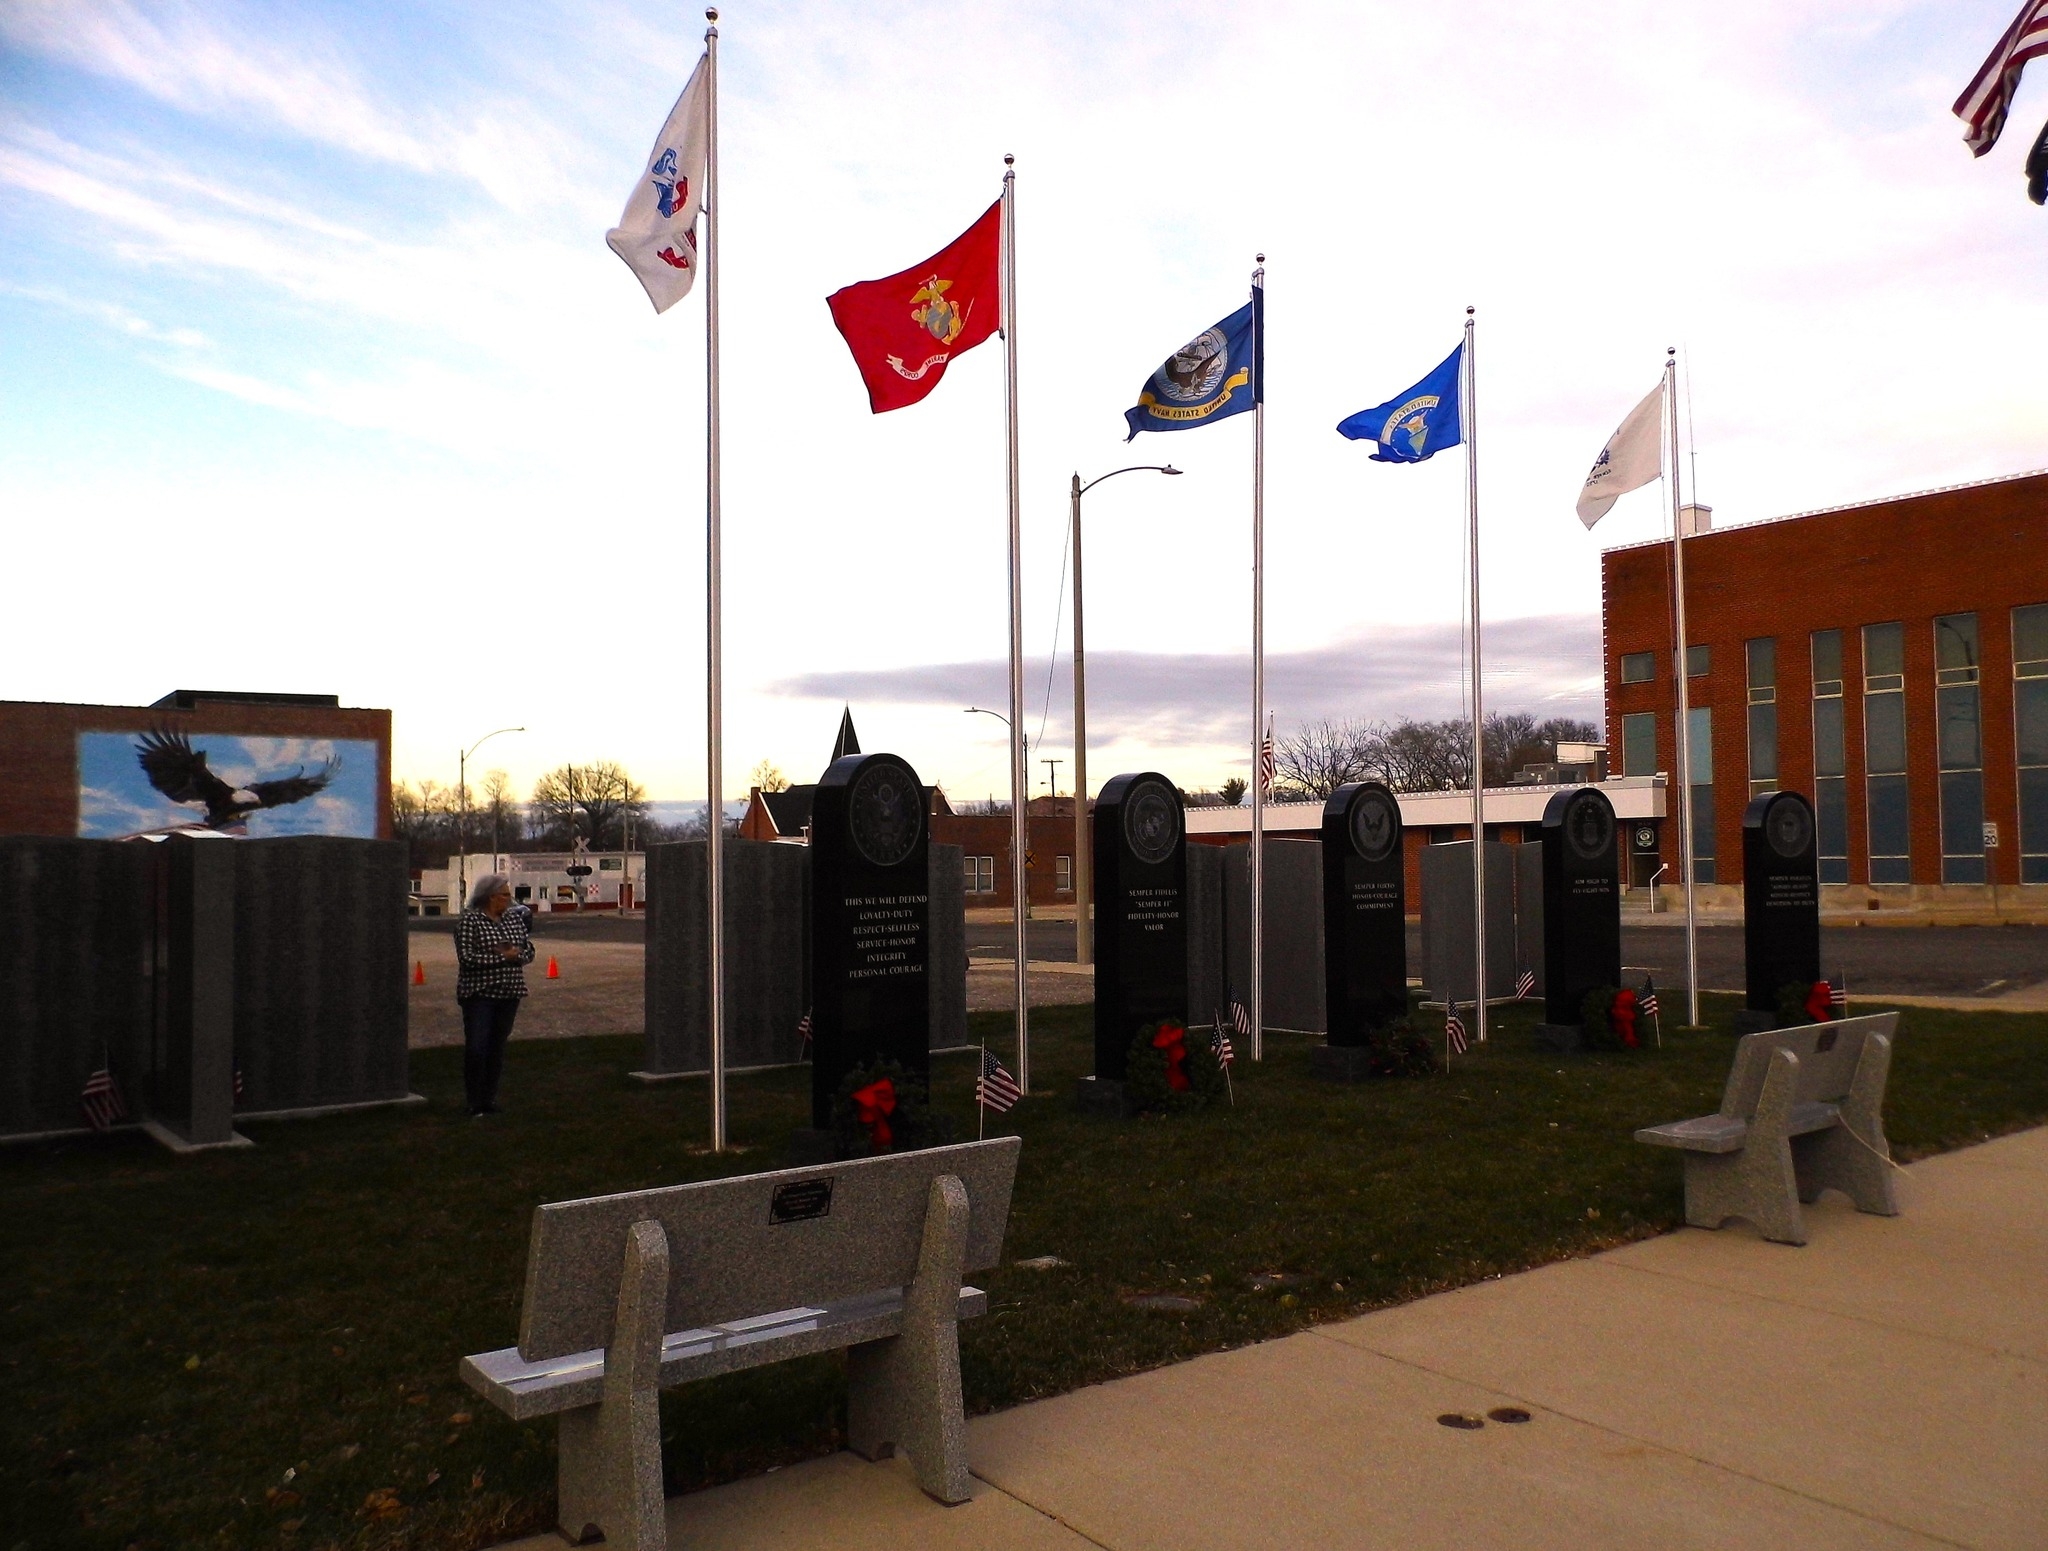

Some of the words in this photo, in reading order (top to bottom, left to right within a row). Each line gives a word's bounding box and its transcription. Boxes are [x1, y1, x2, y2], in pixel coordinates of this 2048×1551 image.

[1984, 835, 1998, 845] 20
[1129, 889, 1153, 897] SEMPER
[845, 897, 863, 906] THIS
[864, 896, 877, 905] WE
[878, 896, 896, 904] WILL
[898, 895, 928, 904] DEFEND
[1356, 902, 1394, 910] COMMITMENT
[1144, 923, 1164, 931] VALOR
[867, 952, 907, 963] INTEGRITY
[848, 967, 887, 979] PERSONAL
[889, 964, 923, 975] COURAGE
